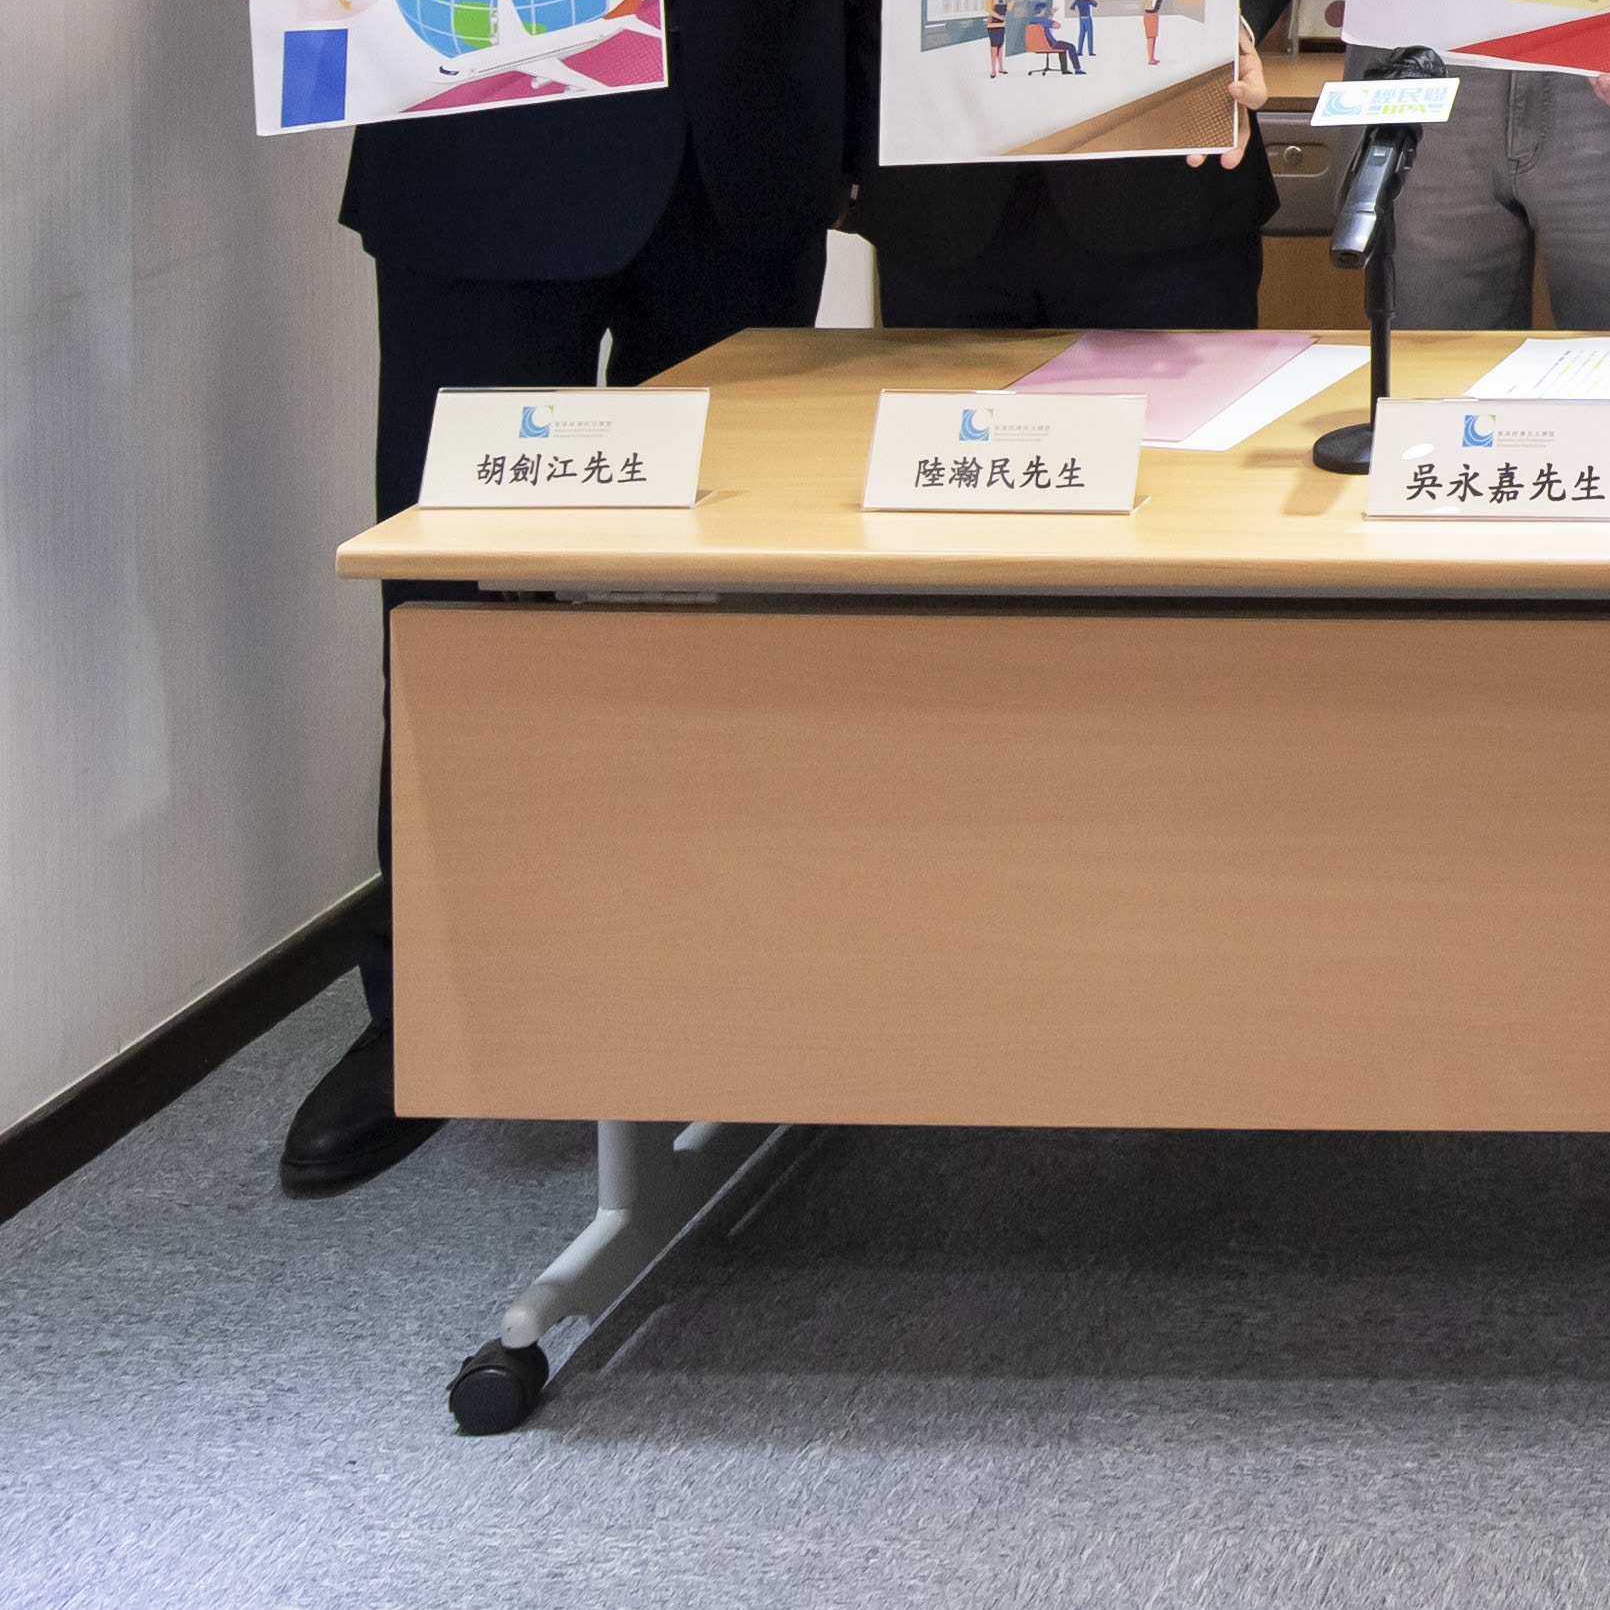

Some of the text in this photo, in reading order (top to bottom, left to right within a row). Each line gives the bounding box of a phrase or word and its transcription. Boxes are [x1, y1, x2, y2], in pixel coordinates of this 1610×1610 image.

[1370, 87, 1449, 104] 經民聯
[1381, 103, 1427, 115] BPA
[476, 450, 648, 486] 胡劍江先生
[914, 455, 1086, 489] 陸瀚民先生
[1406, 462, 1606, 504] 吳永嘉先生
